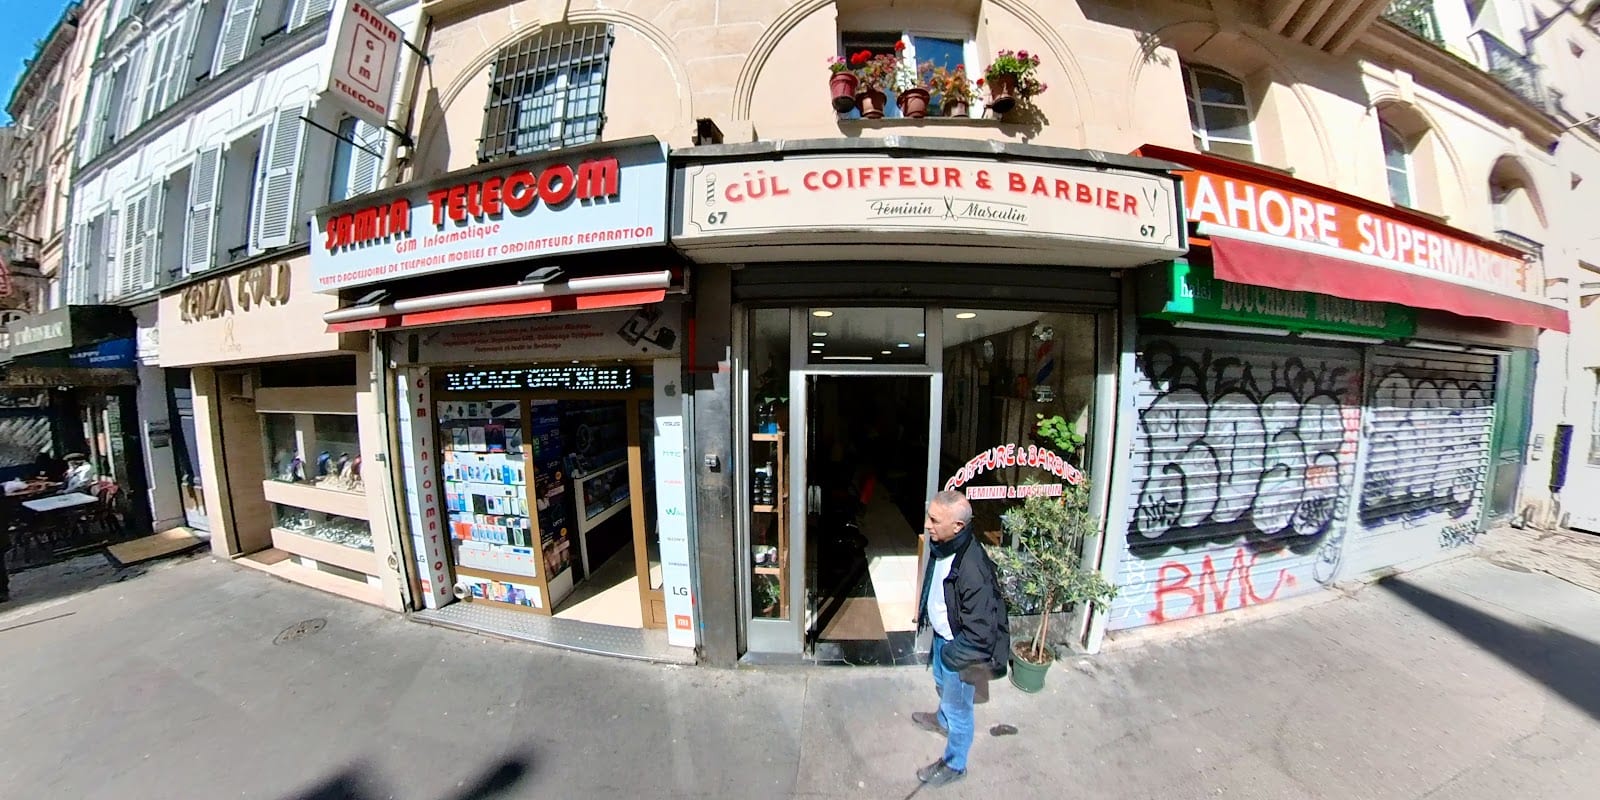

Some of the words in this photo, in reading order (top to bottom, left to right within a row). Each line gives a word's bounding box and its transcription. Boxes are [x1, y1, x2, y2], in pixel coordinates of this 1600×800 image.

[352, 3, 397, 42] SAMIA
[335, 79, 385, 115] TELECOM
[325, 198, 411, 250] SAMIA
[427, 156, 620, 226] TELECOM
[724, 171, 789, 204] GÜL
[803, 166, 963, 190] COIFFEUR
[975, 169, 993, 189] &
[1009, 172, 1138, 217] BARBIER
[707, 211, 728, 225] 67
[869, 200, 936, 218] Féminin
[960, 202, 1028, 223] Masculin
[1186, 176, 1340, 248] AHORE
[396, 238, 417, 254] GSM
[424, 223, 501, 248] Informatique
[1140, 223, 1156, 238] 67
[388, 263, 398, 273] DE
[401, 254, 446, 272] TELEPHONIE
[448, 248, 485, 262] MOBILES
[488, 245, 498, 257] ET
[501, 235, 574, 254] ORDINATEURS
[577, 226, 654, 244] REPARATION
[944, 443, 1016, 491] COIFFURE
[1017, 446, 1027, 466] &
[966, 485, 1008, 500] FEMININ
[1008, 485, 1016, 499] &
[673, 586, 688, 596] LG
